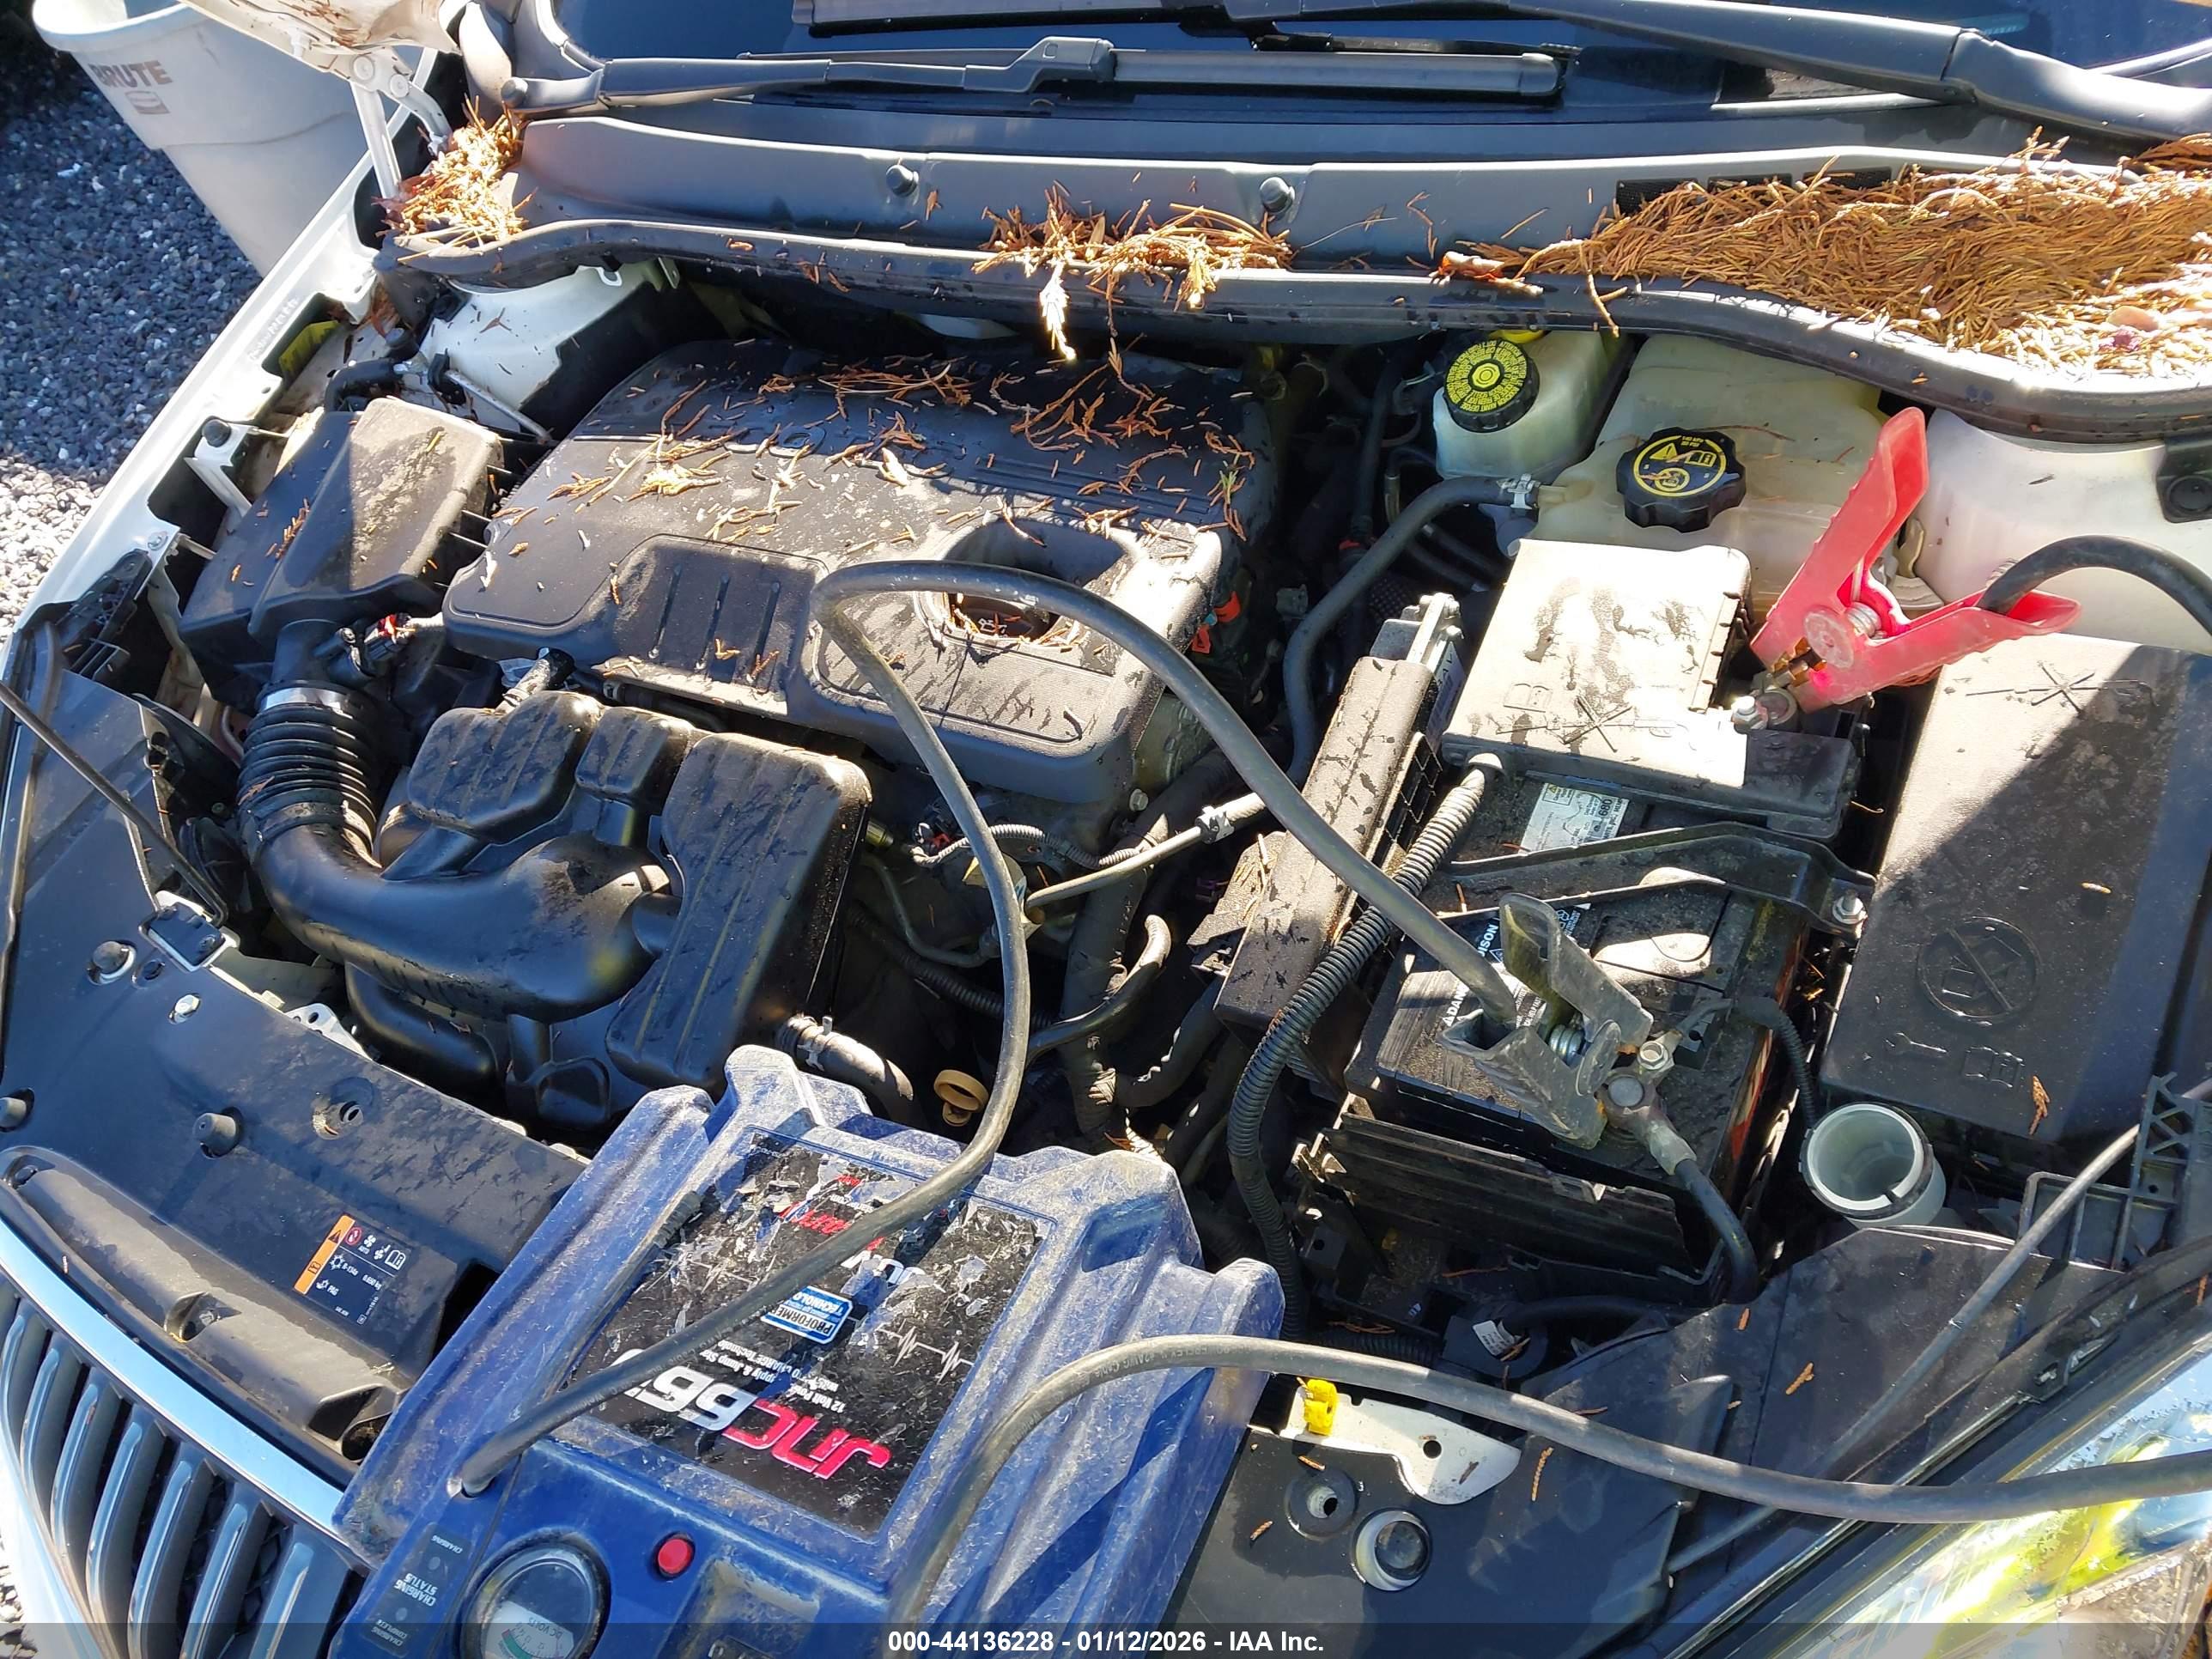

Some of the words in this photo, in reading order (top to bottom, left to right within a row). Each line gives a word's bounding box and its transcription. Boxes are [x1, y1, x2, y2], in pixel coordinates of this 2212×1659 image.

[88, 60, 173, 88] BRUTE
[1598, 798, 1613, 817] 680
[1478, 924, 1499, 957] ISON
[1446, 982, 1470, 1024] DAN
[792, 1291, 843, 1316] TECHNOLO
[717, 1339, 758, 1363] Technolo
[717, 1353, 744, 1371] Jump
[752, 1368, 777, 1383] pply
[787, 1382, 812, 1401] Pow
[811, 1391, 831, 1410] Volt
[830, 1399, 846, 1413] 12
[394, 1578, 436, 1607] CHARGING
[404, 1572, 438, 1596] STATUS
